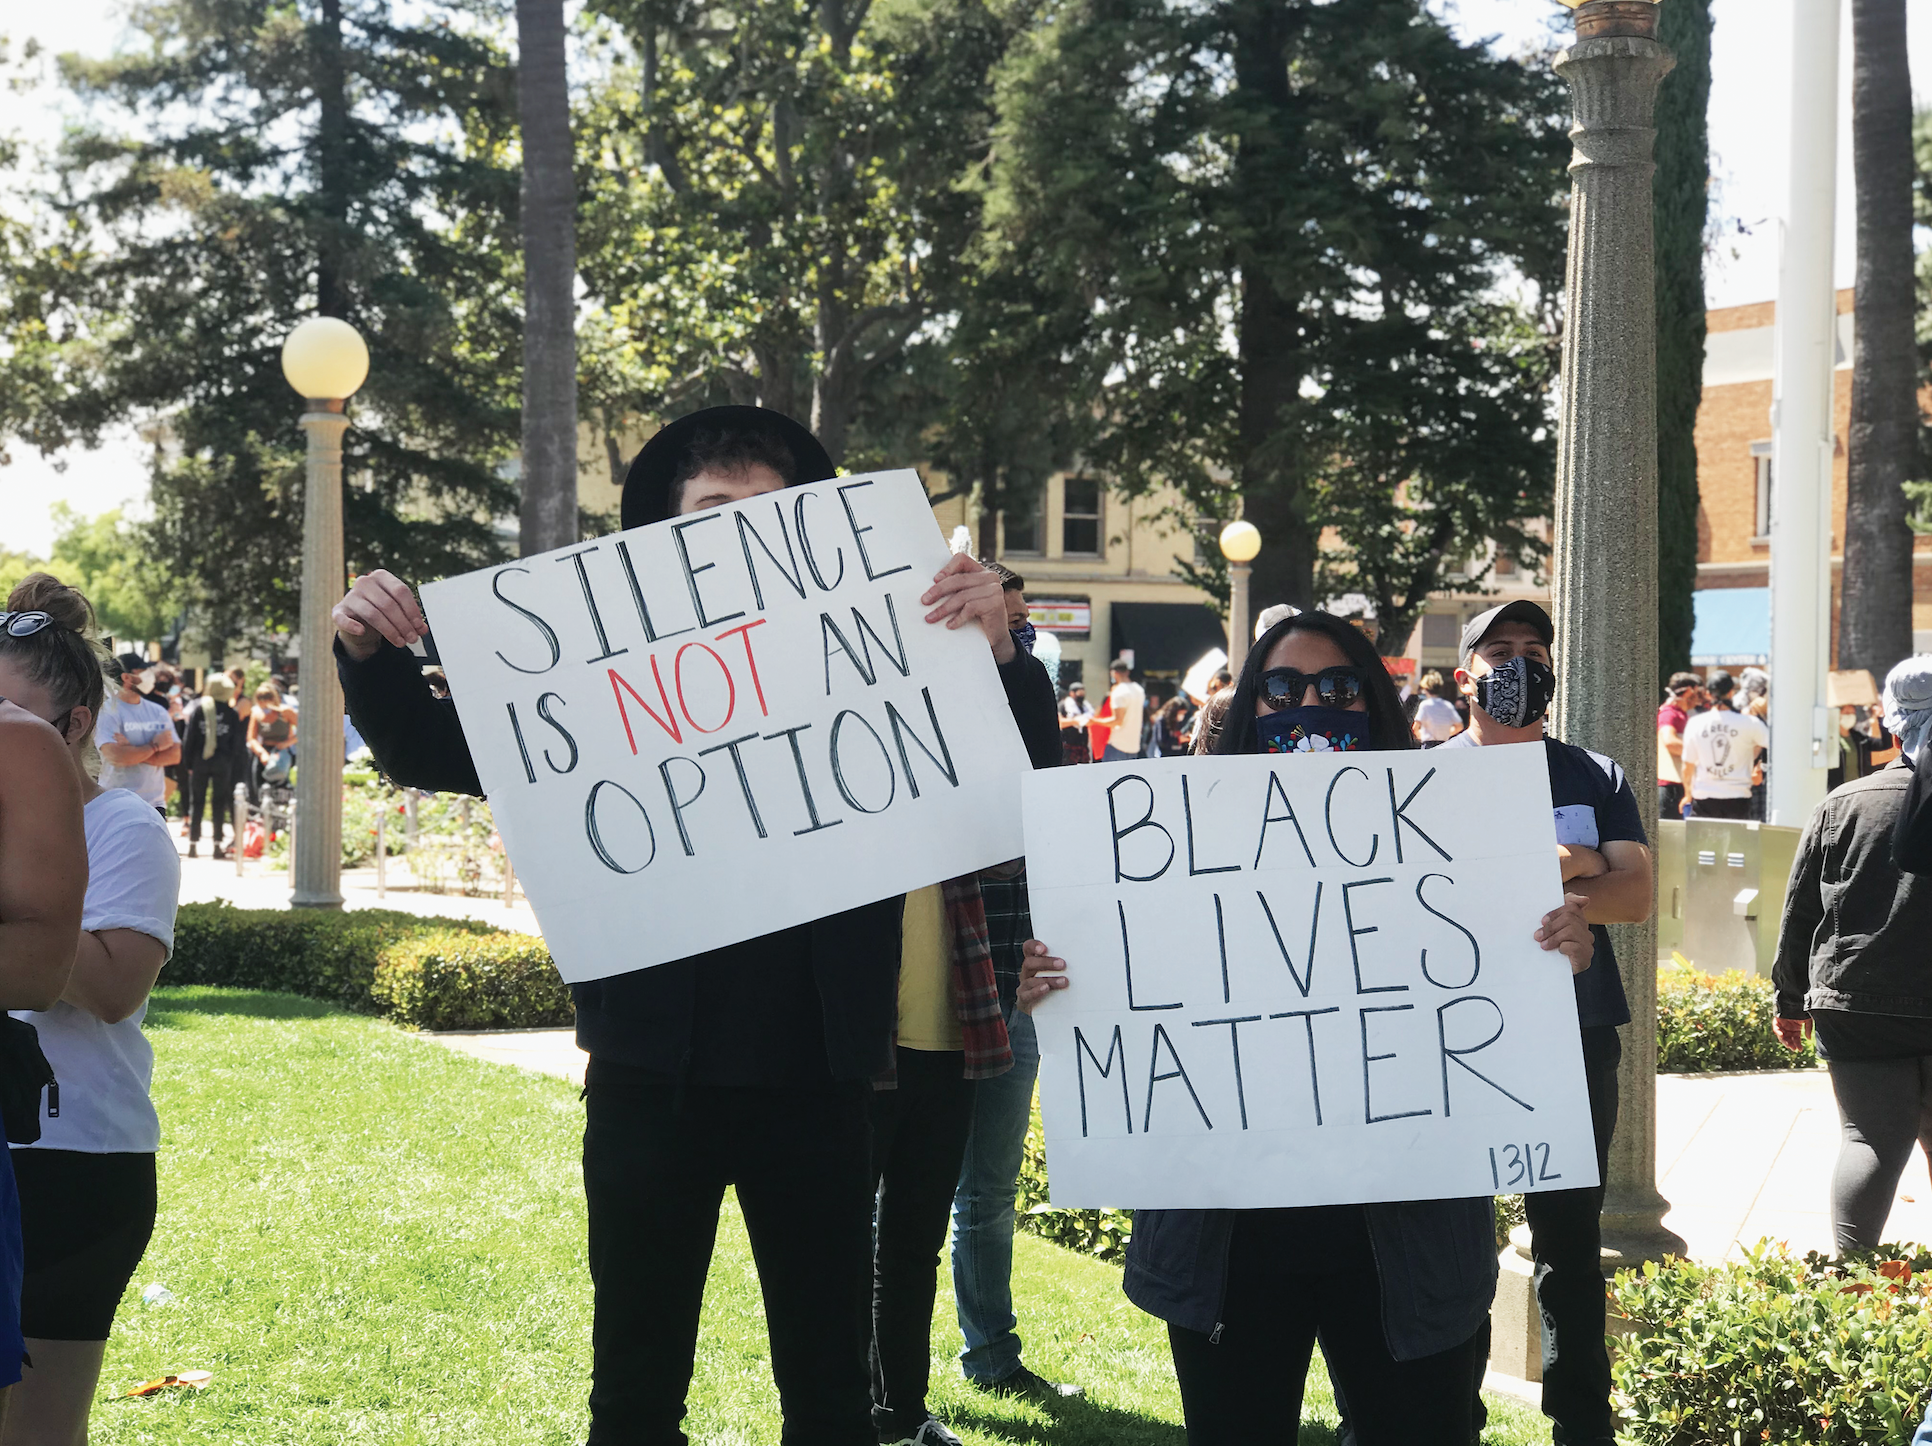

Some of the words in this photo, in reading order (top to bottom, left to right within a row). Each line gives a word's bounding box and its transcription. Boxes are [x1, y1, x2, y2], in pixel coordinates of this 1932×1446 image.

[492, 480, 912, 674] SILENCE
[505, 691, 579, 784] IS
[607, 619, 768, 755] NOT
[819, 593, 910, 696] AN
[1702, 724, 1738, 738] GREED
[584, 686, 960, 874] OPTION
[1107, 766, 1454, 883] BLACK
[1706, 764, 1734, 778] KILLS
[1117, 874, 1481, 1011] LIVES
[1074, 996, 1535, 1137] MATTER
[1488, 1142, 1562, 1188] 1312
